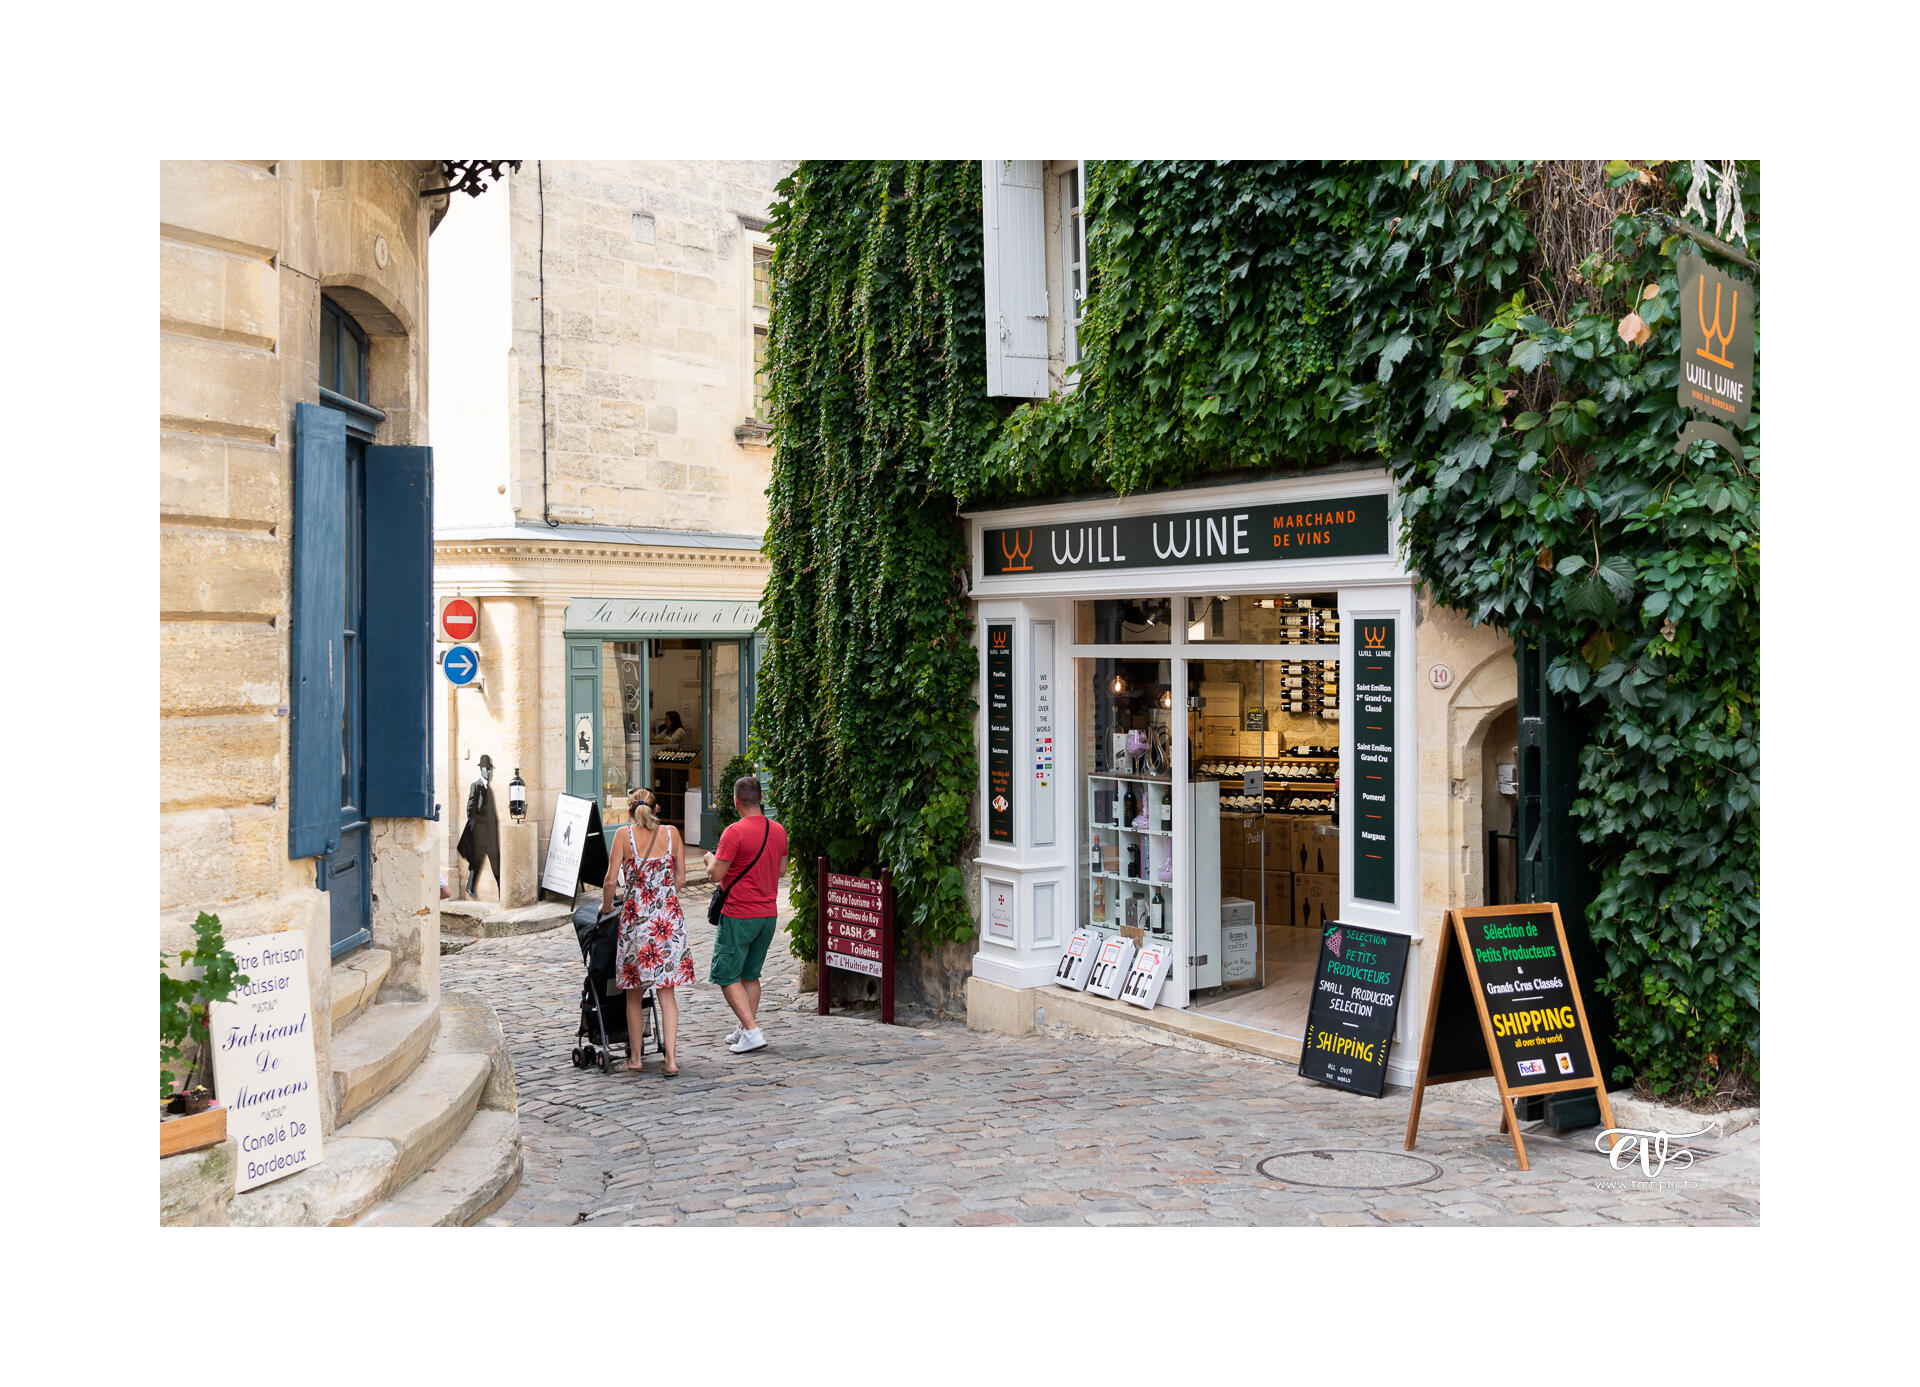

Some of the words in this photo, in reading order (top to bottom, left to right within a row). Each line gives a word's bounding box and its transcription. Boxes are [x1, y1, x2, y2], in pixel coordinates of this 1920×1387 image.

[1686, 361, 1712, 391] WILL
[1715, 373, 1744, 403] WINE
[1273, 510, 1356, 529] MARCHAND
[1051, 525, 1126, 565] WILL
[1153, 514, 1250, 559] WINE
[1273, 534, 1290, 547] DE
[1297, 530, 1331, 545] VINS
[586, 600, 613, 623] La
[619, 601, 702, 623] Fontaine
[1433, 669, 1448, 683] 10
[1370, 684, 1391, 692] Emilion
[1364, 694, 1381, 702] Grand
[1365, 705, 1383, 713] Classé
[1356, 743, 1371, 751] Saint
[1371, 744, 1392, 752] Emilion
[1360, 754, 1377, 762] Grand
[1377, 755, 1388, 763] Cru
[1362, 793, 1386, 802] Pomerol
[1361, 831, 1386, 841] Margaux
[827, 891, 841, 903] Office
[841, 893, 848, 904] de
[848, 894, 871, 908] Tourisme
[841, 908, 862, 921] Château
[862, 911, 869, 922] du
[840, 924, 862, 939] CASH
[1483, 922, 1525, 940] Sélection
[1526, 921, 1538, 937] de
[262, 948, 305, 967] Artisan
[850, 942, 880, 959] Toilettes
[1346, 948, 1377, 966] PETITS
[1476, 947, 1502, 963] Petits
[1502, 944, 1557, 962] Producteurs
[869, 963, 879, 975] Pie
[1327, 960, 1391, 985] PRODUCTEURS
[1517, 966, 1524, 975] &
[1319, 979, 1344, 996] SMALL
[1351, 986, 1395, 1007] PRODUCERS
[1487, 981, 1514, 995] Grands
[1514, 980, 1533, 992] Crus
[1533, 976, 1563, 991] Classés
[1329, 998, 1372, 1018] SELECTION
[1493, 1005, 1576, 1037] SHIPPING
[222, 1013, 306, 1050] Fabricant
[1522, 1038, 1535, 1047] over
[1535, 1036, 1546, 1046] the
[1546, 1033, 1563, 1044] world
[1316, 1031, 1375, 1063] SHIPPING
[256, 1049, 280, 1074] De
[1327, 1062, 1337, 1071] ALL
[1340, 1066, 1353, 1075] OVER
[1520, 1061, 1544, 1074] FedEx
[1325, 1072, 1334, 1080] THE
[1337, 1076, 1351, 1084] WORLD
[228, 1080, 308, 1111] Macarons
[242, 1125, 287, 1152] Canelé
[290, 1121, 307, 1138] De
[247, 1149, 306, 1180] Bordeaux
